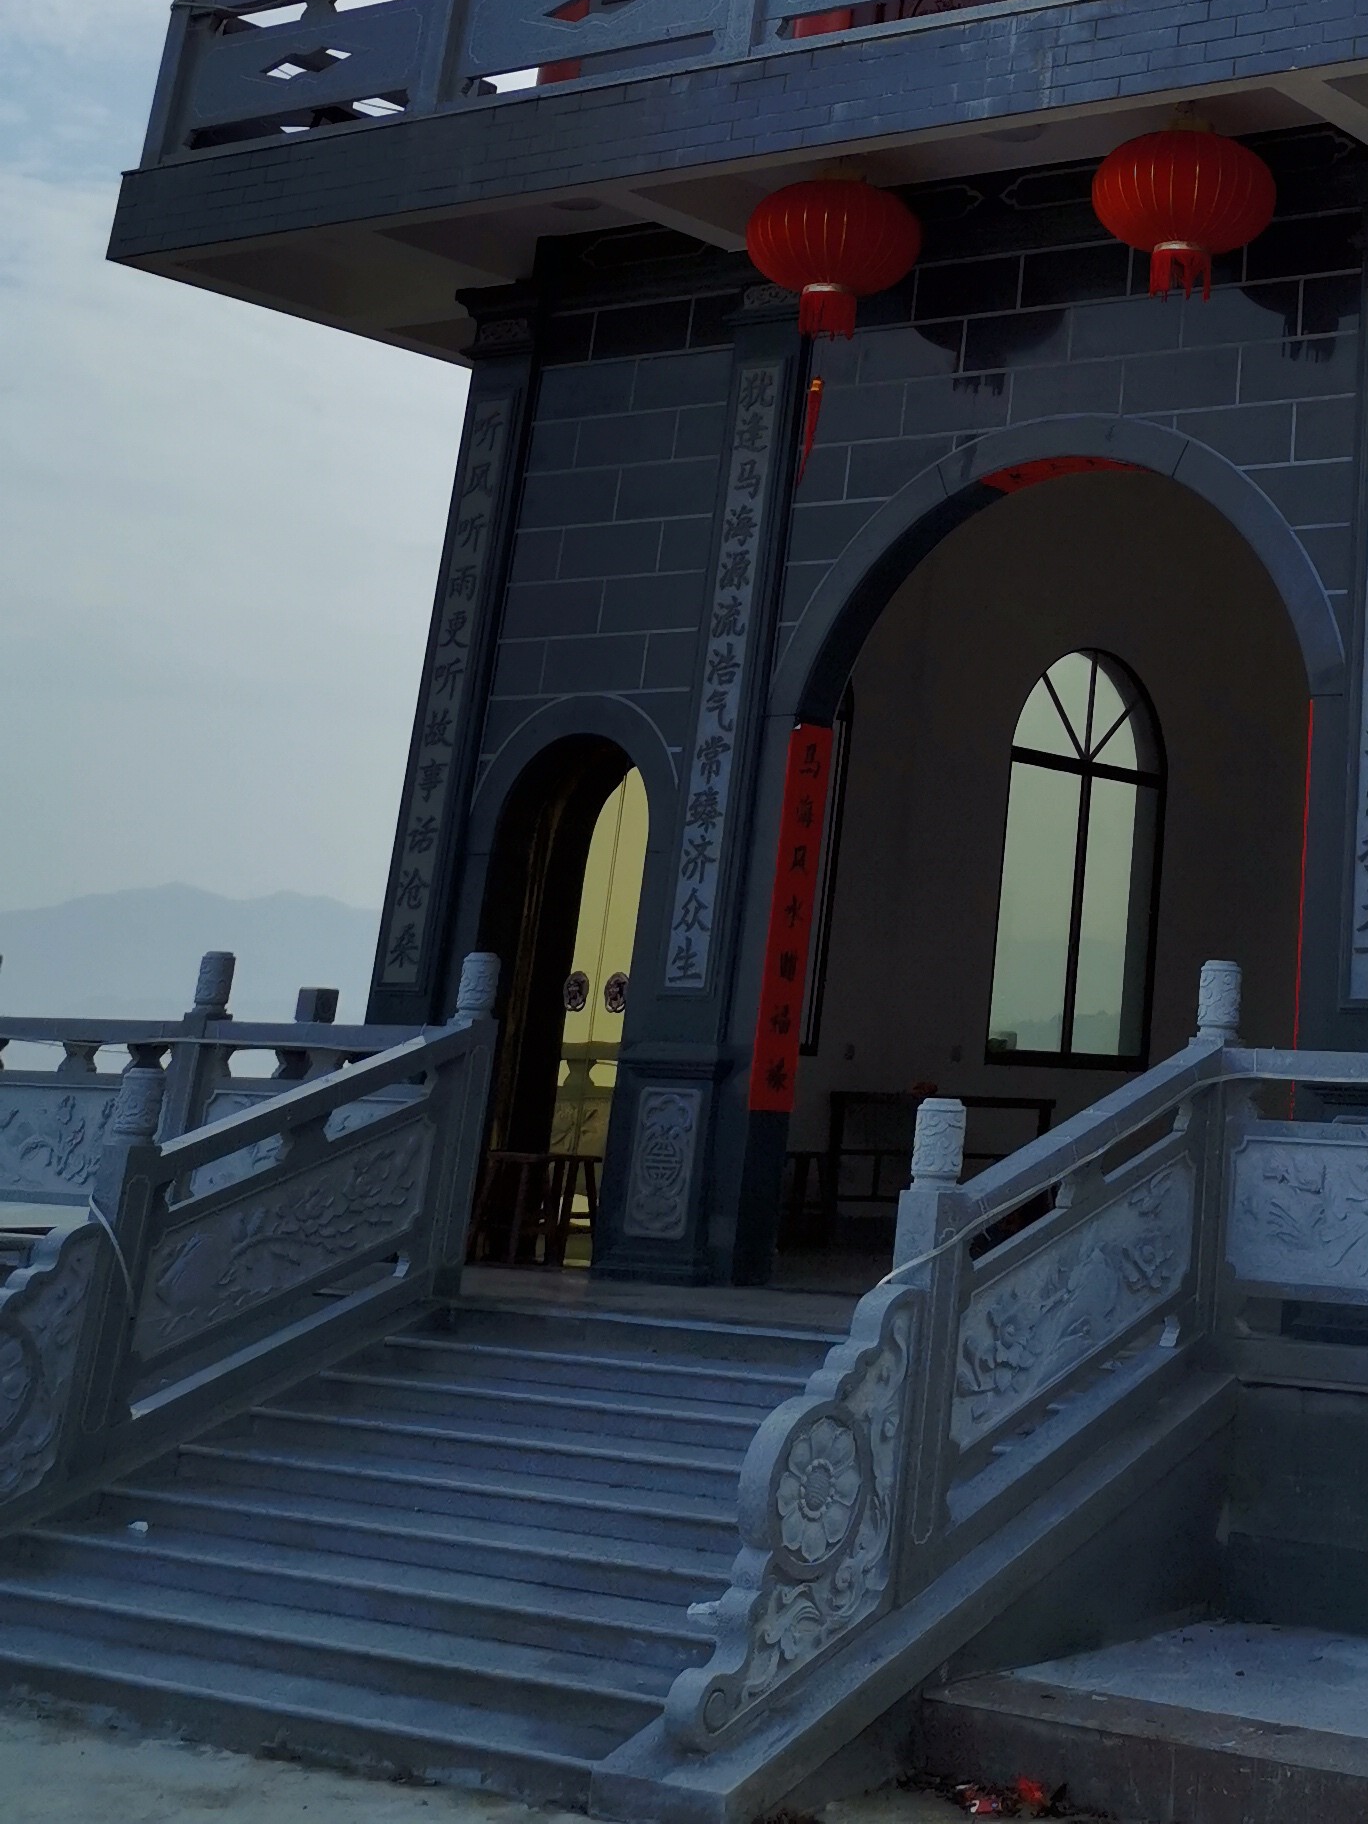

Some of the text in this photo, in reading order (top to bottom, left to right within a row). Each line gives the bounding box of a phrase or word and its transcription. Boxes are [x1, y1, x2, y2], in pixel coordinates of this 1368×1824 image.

[388, 410, 503, 969] 听风听雨更听故事话沧桑
